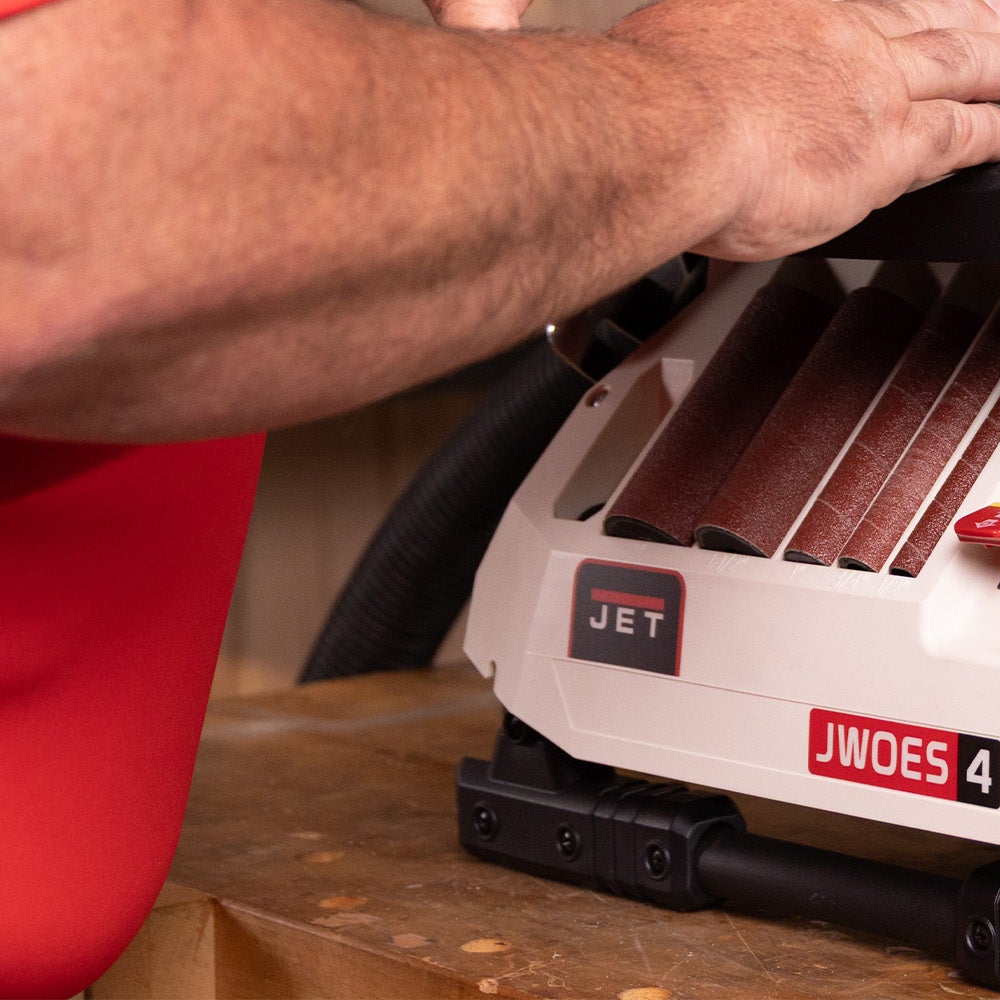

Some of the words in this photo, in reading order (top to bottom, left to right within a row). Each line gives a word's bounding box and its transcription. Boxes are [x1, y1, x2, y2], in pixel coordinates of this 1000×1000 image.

[589, 604, 664, 638] JET
[815, 722, 949, 785] JWOES
[966, 748, 992, 794] 4
